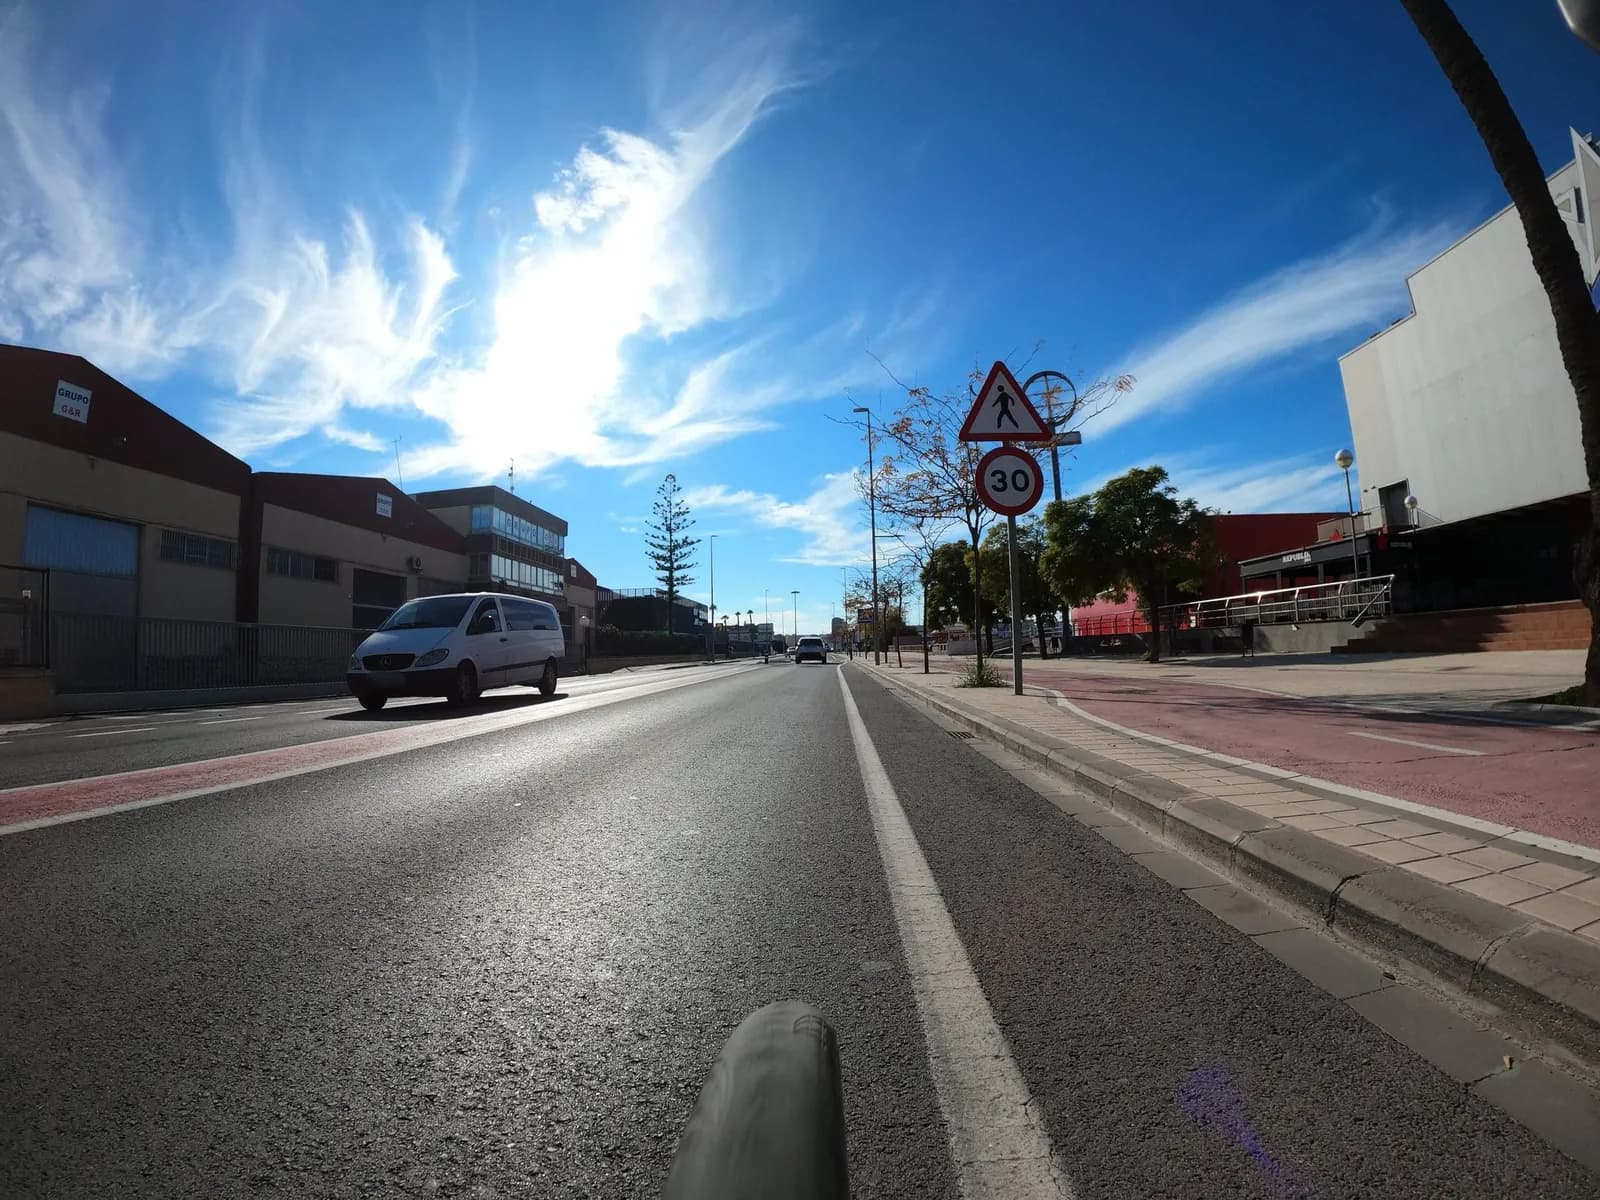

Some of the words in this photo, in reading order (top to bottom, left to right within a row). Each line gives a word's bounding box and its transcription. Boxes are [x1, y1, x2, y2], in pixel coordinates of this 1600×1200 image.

[58, 387, 89, 404] GRUPO
[62, 405, 81, 417] G&R
[990, 469, 1030, 492] 30
